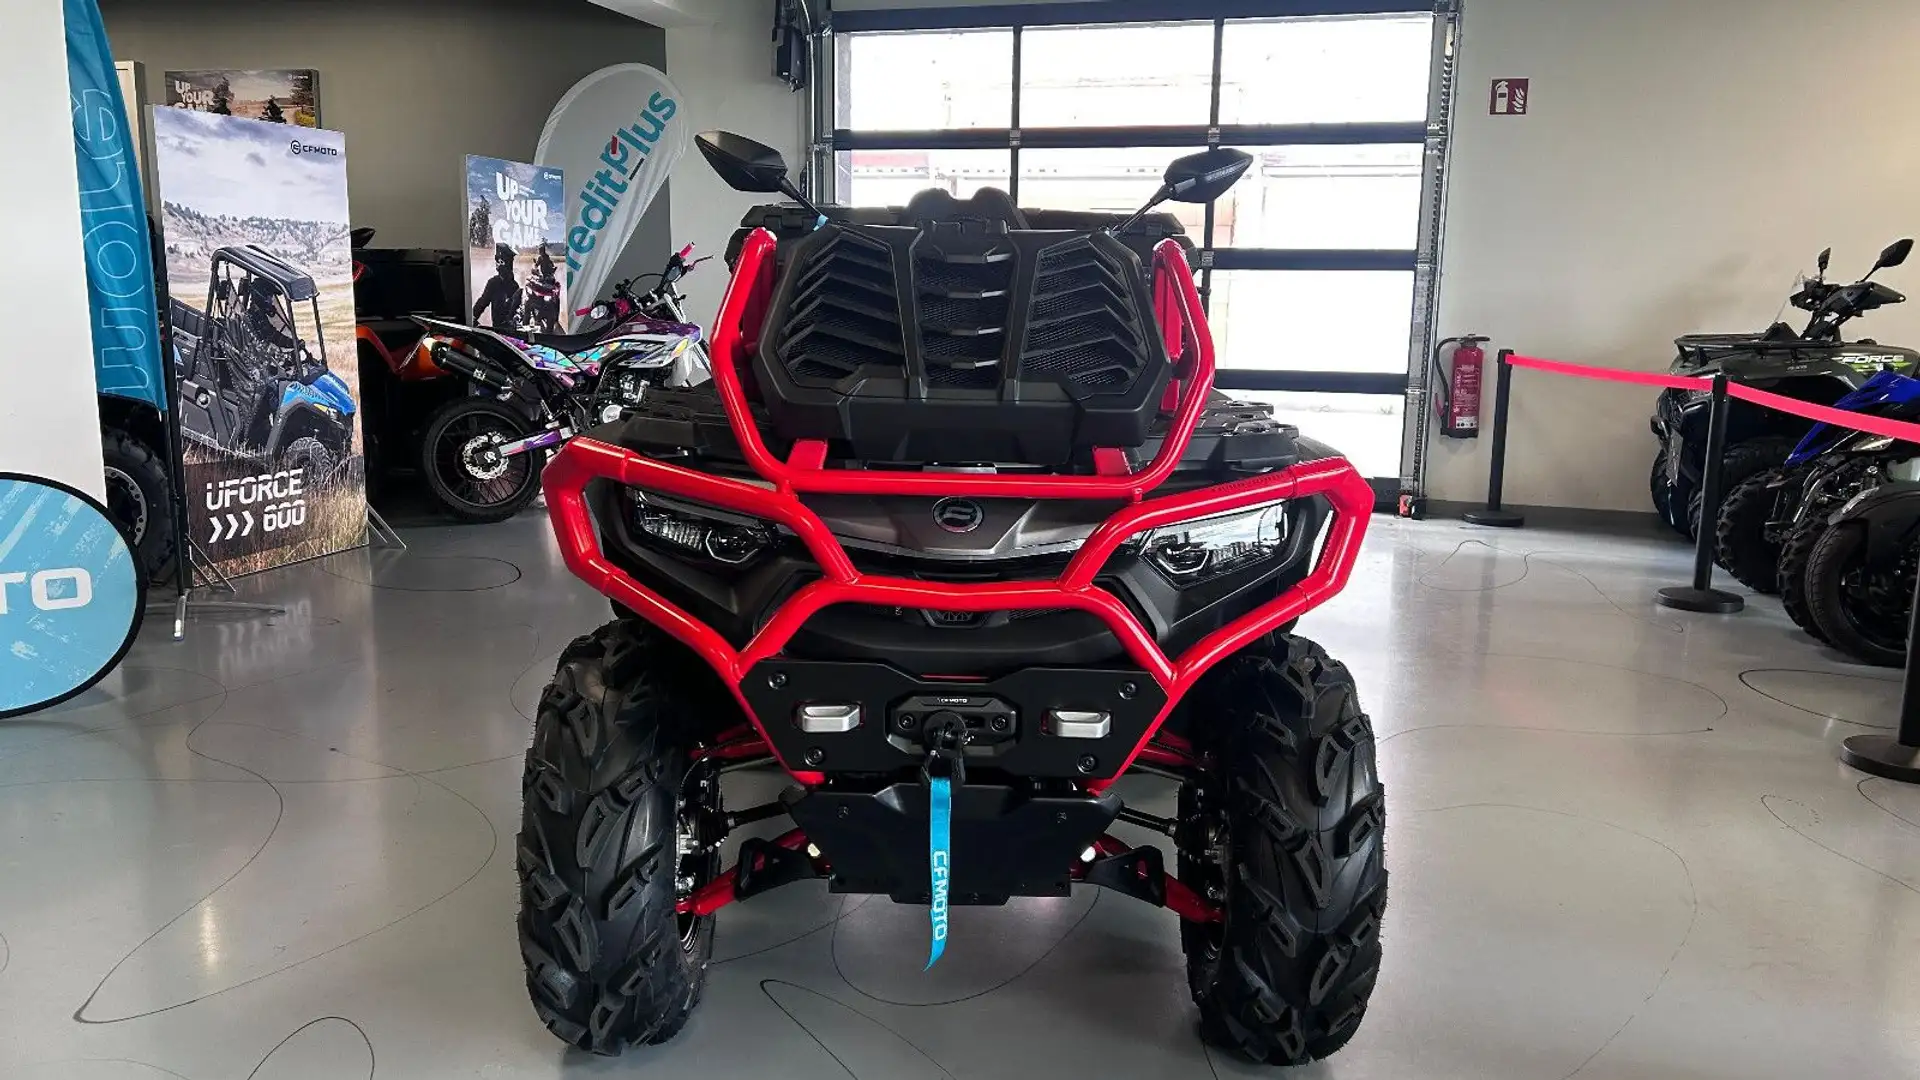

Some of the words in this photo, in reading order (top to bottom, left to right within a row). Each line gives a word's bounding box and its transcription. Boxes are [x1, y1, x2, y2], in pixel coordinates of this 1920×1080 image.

[175, 80, 191, 94] UP
[181, 90, 215, 106] YOUR
[302, 145, 338, 156] CFMOTO
[496, 171, 519, 201] UP
[567, 91, 677, 290] reditPlus
[504, 199, 550, 231] YOUR
[206, 468, 304, 511] UFORCE
[262, 499, 306, 532] 600
[933, 850, 948, 941] CFMOTO
